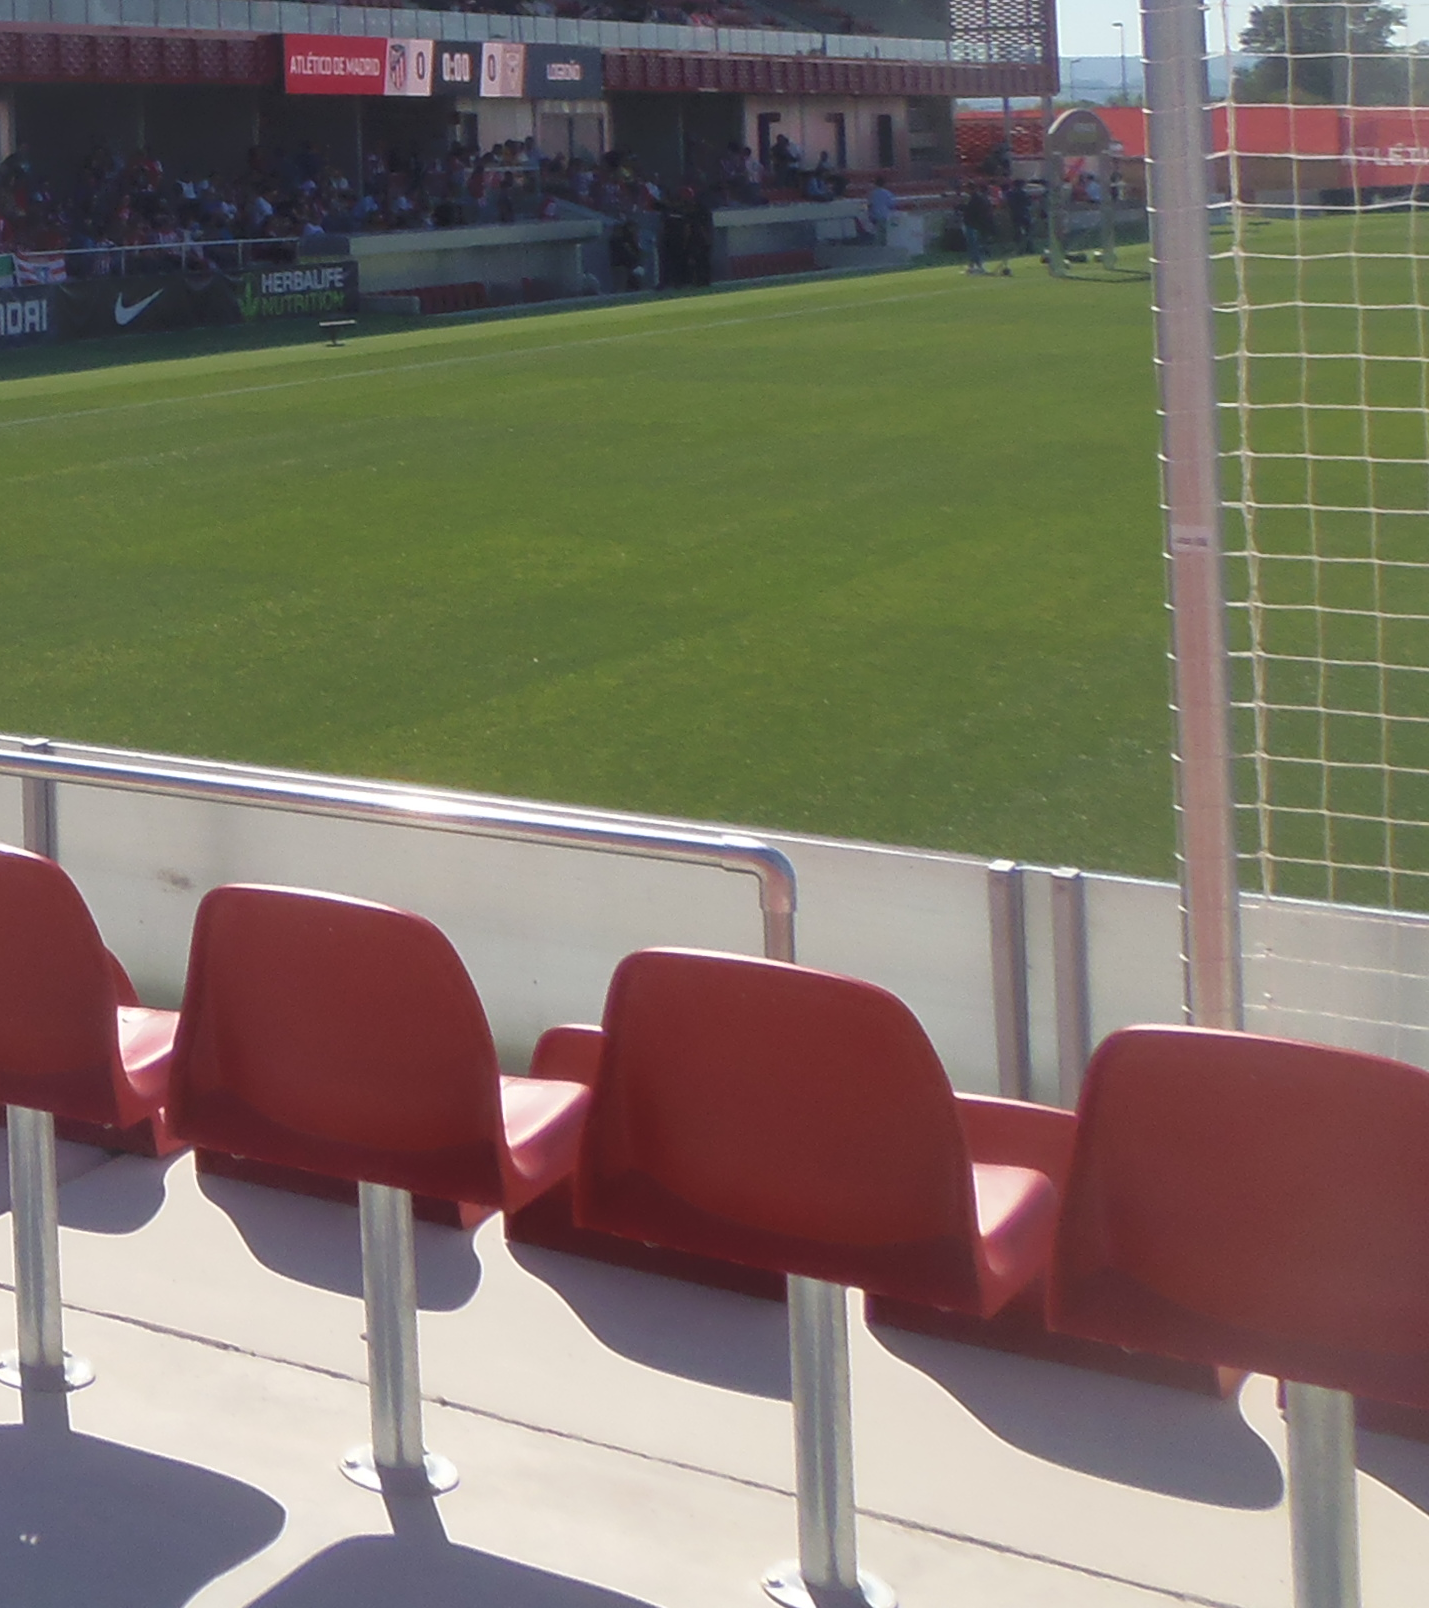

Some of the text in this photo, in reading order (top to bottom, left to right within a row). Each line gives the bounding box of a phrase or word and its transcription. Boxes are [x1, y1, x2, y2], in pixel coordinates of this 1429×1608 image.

[290, 52, 381, 77] ATLÉTICO DE MADRID
[416, 51, 425, 80] 0
[487, 53, 497, 82] 0
[261, 267, 344, 293] HERBALIFE
[261, 290, 345, 315] NUTRITION
